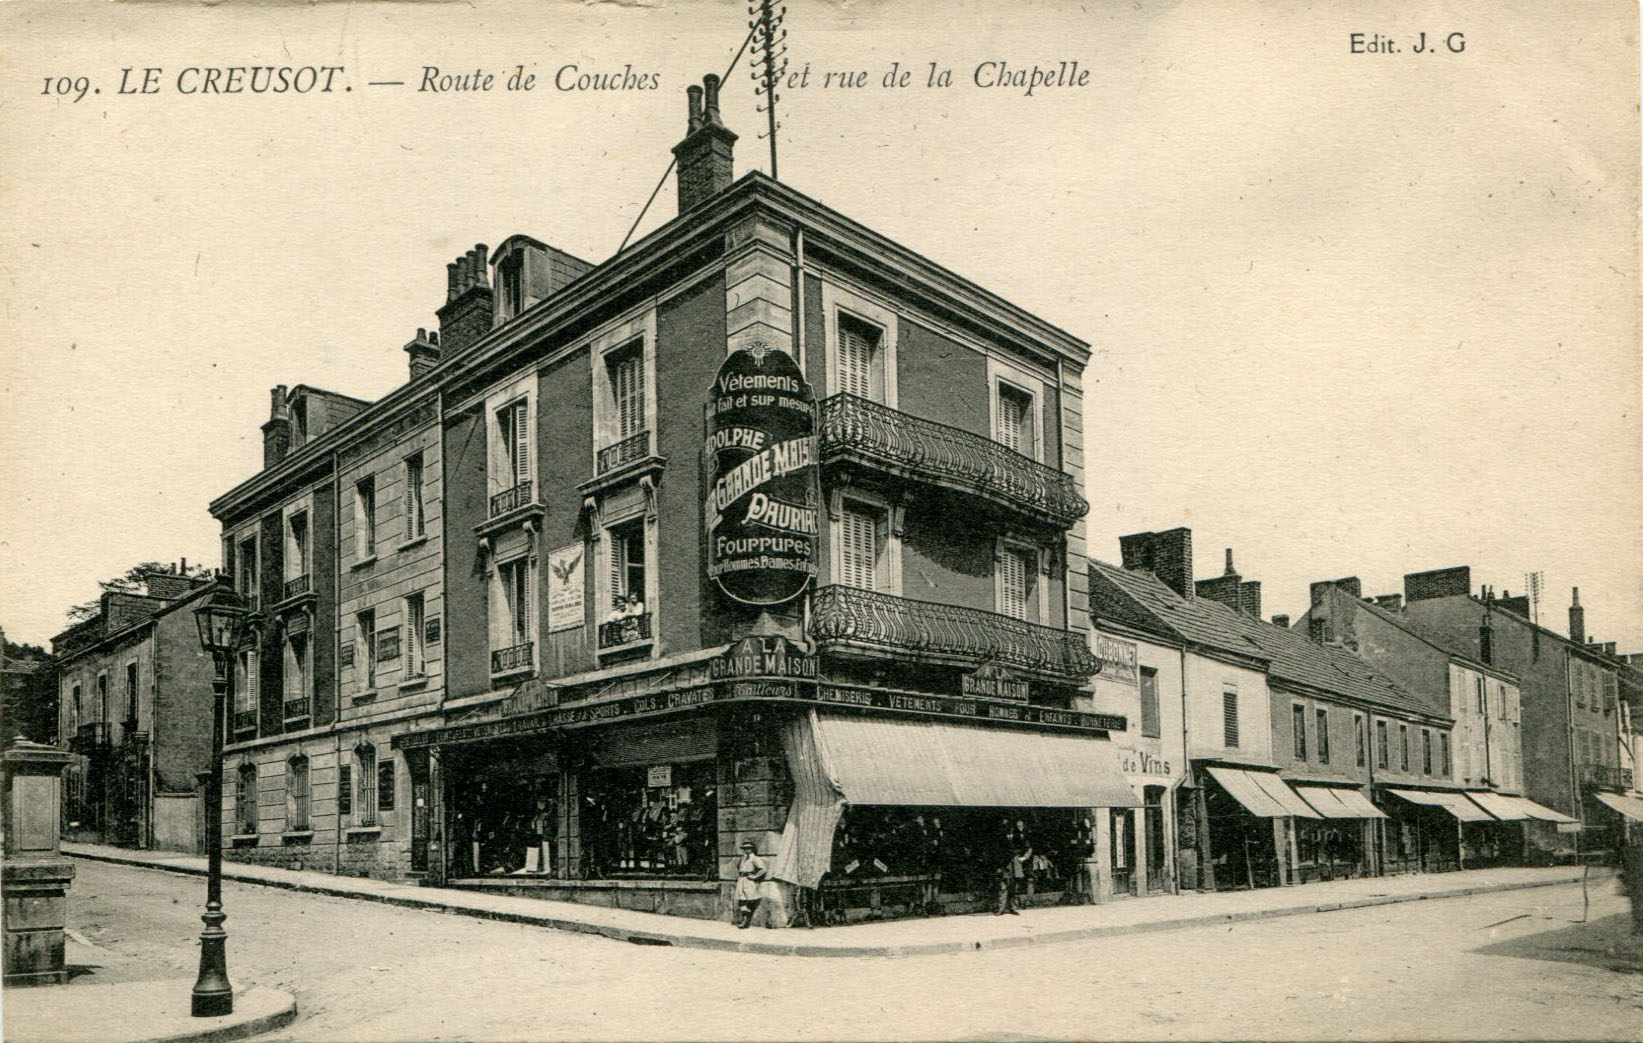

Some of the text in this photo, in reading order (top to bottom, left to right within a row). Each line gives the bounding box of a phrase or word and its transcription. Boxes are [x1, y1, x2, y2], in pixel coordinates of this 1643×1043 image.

[736, 393, 748, 408] et
[717, 449, 772, 511] GRANDE
[717, 536, 811, 558] Fourrures
[742, 637, 786, 653] A LA
[711, 653, 816, 677] GRANDE MAISON
[964, 675, 1027, 700] GRANDE MAISON
[590, 703, 621, 720] SPORTS
[634, 697, 657, 713] COLS
[667, 687, 715, 708] CRAVATES
[816, 685, 873, 706] CHEMISERIE
[955, 702, 976, 715] POUR
[989, 706, 1019, 720] HOMMES
[1039, 710, 1072, 725] ENFANTS
[1122, 758, 1137, 773] de
[1139, 751, 1171, 775] Vins
